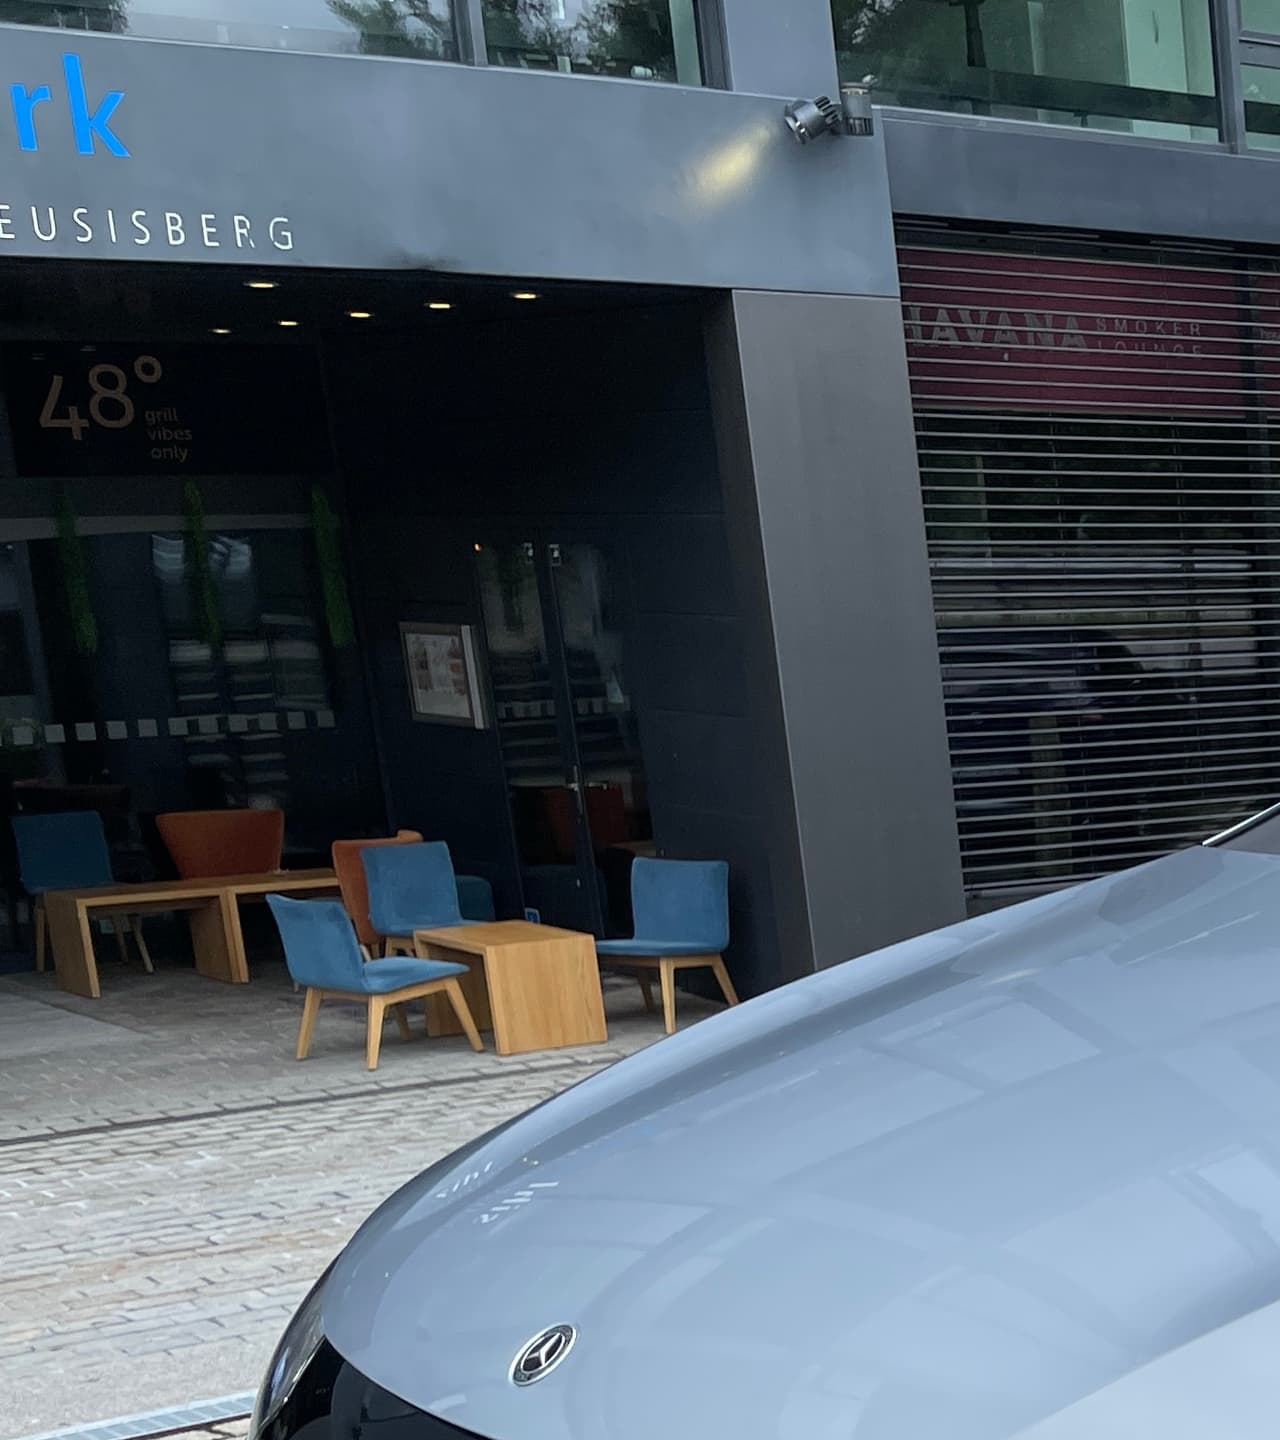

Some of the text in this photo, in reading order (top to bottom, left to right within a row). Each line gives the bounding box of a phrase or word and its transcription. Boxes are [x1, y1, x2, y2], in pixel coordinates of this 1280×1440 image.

[144, 407, 177, 423] grill
[147, 427, 193, 441] vibes
[151, 444, 188, 463] only
